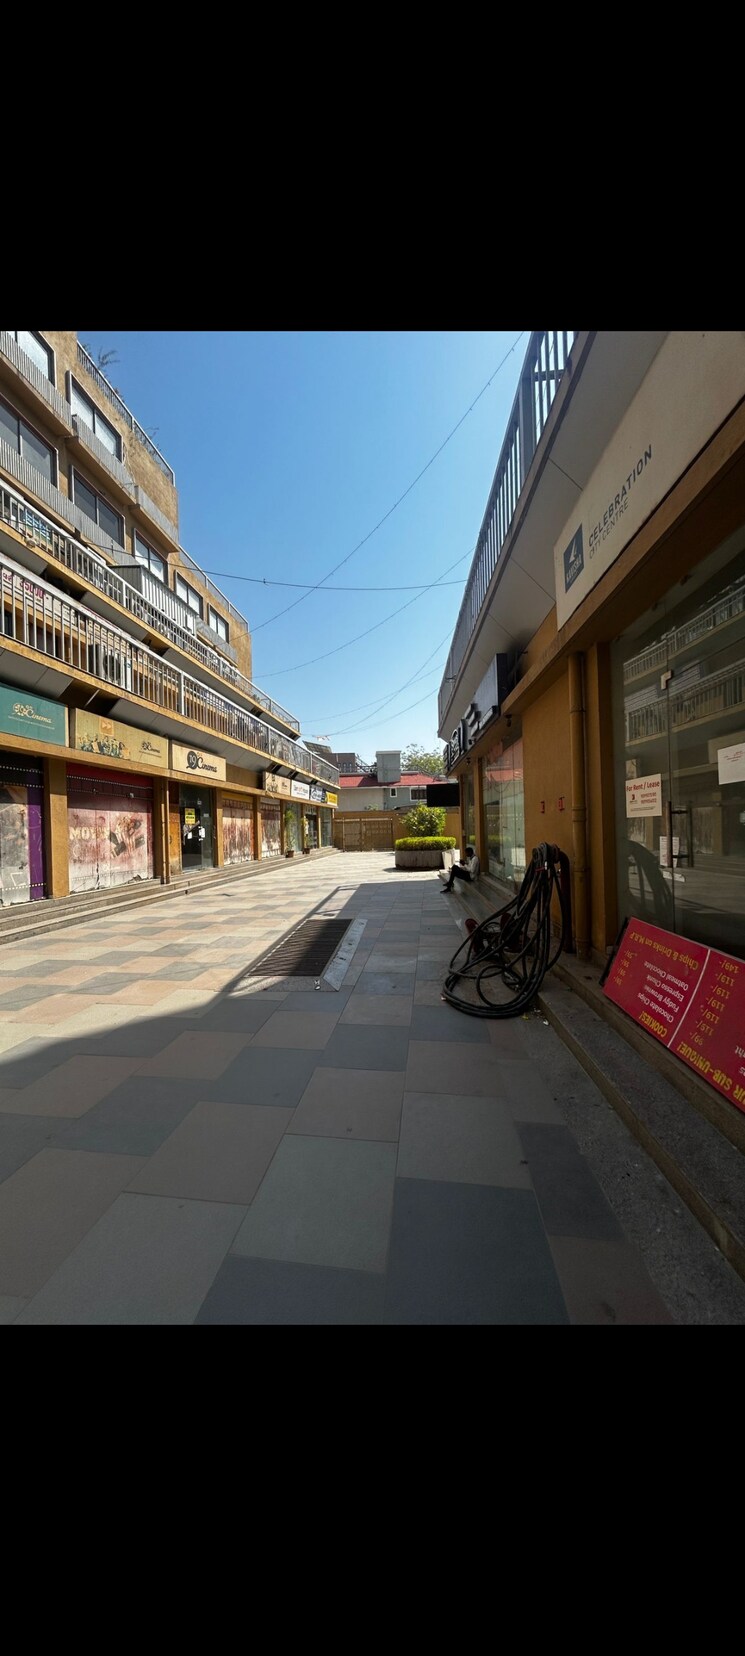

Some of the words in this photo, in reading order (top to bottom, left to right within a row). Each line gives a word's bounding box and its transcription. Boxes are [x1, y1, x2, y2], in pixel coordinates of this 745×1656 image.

[589, 444, 652, 547] CELEBRATION
[589, 540, 600, 559] CITY
[602, 497, 629, 541] CENTRE
[666, 974, 689, 991] Oatmeal
[637, 992, 650, 1006] Chips
[661, 984, 685, 1002] Espresso
[650, 1001, 674, 1023] Chocolate
[662, 997, 680, 1012] Fudgy
[638, 1010, 668, 1038] COOKIES!
